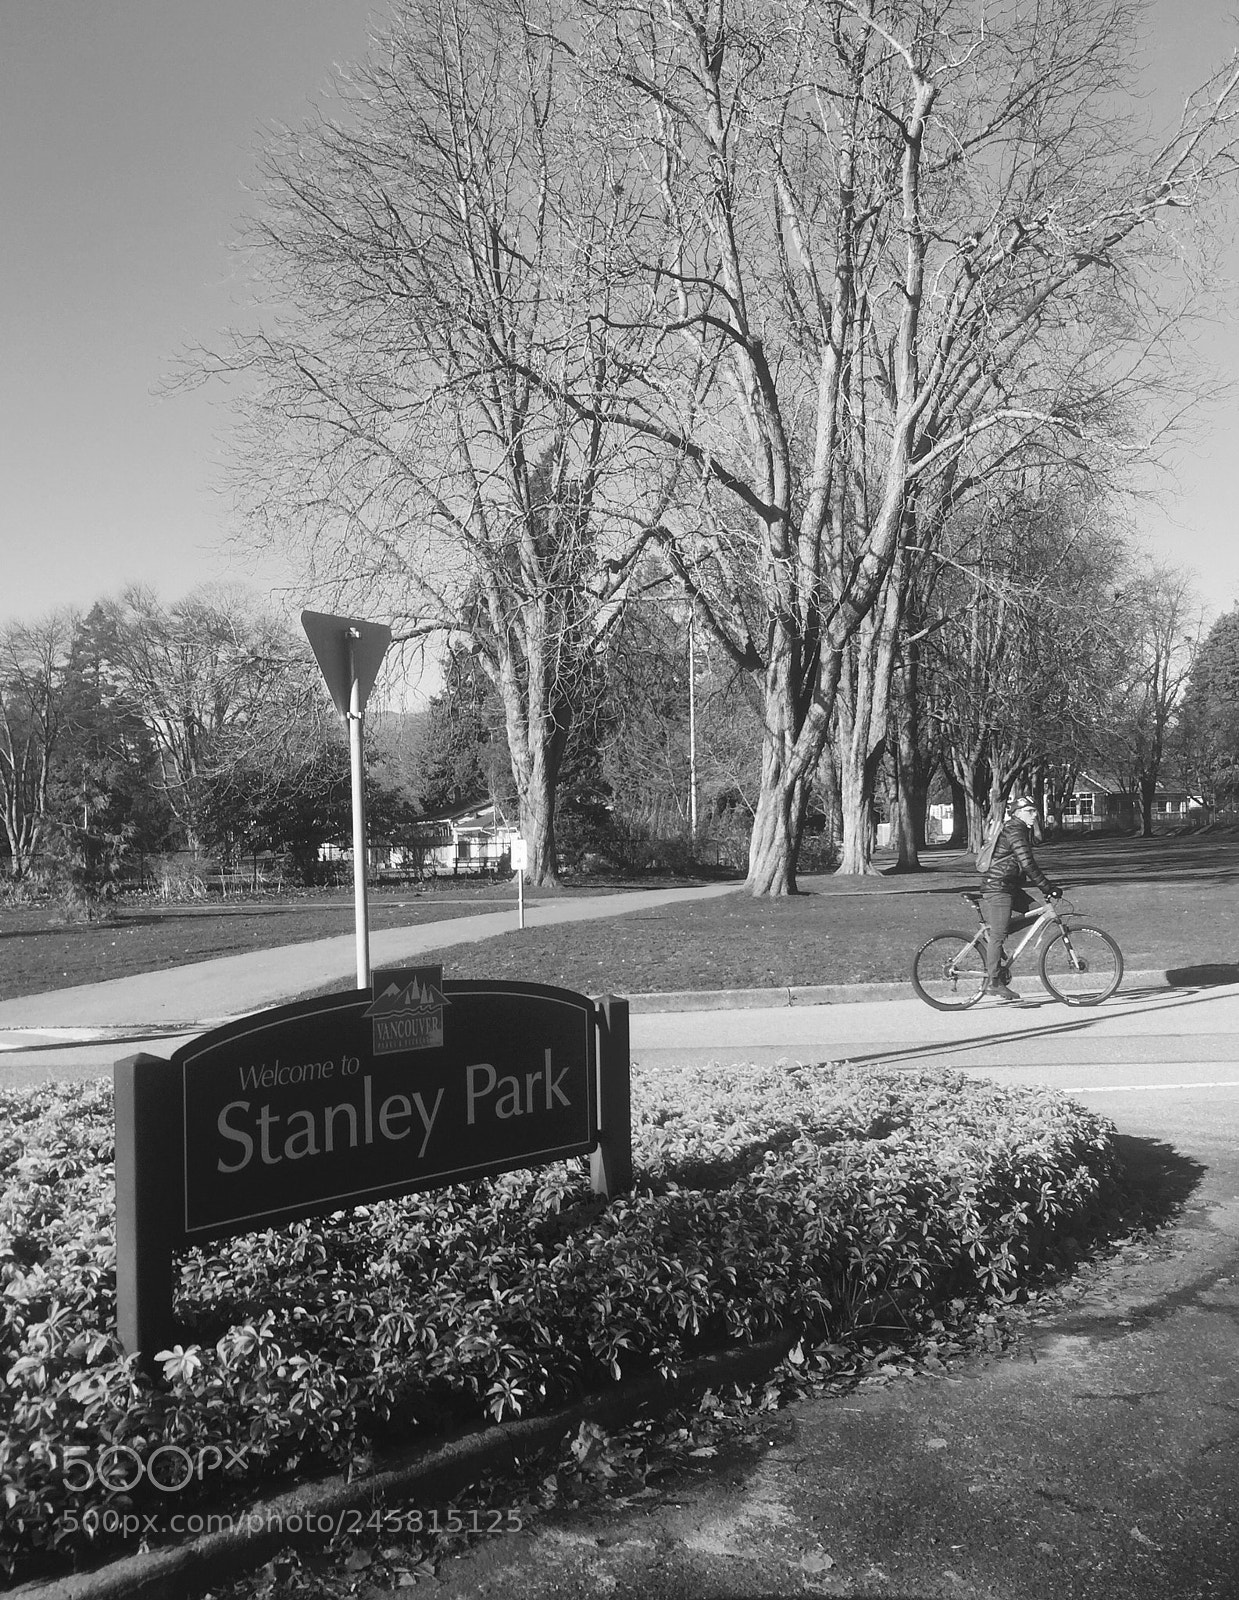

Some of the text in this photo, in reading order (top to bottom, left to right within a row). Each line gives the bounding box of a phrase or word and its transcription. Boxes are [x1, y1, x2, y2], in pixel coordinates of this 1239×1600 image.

[377, 1016, 439, 1040] VANCOUVER
[239, 1054, 361, 1091] Welcome to
[217, 1048, 571, 1173] Stanley Park
